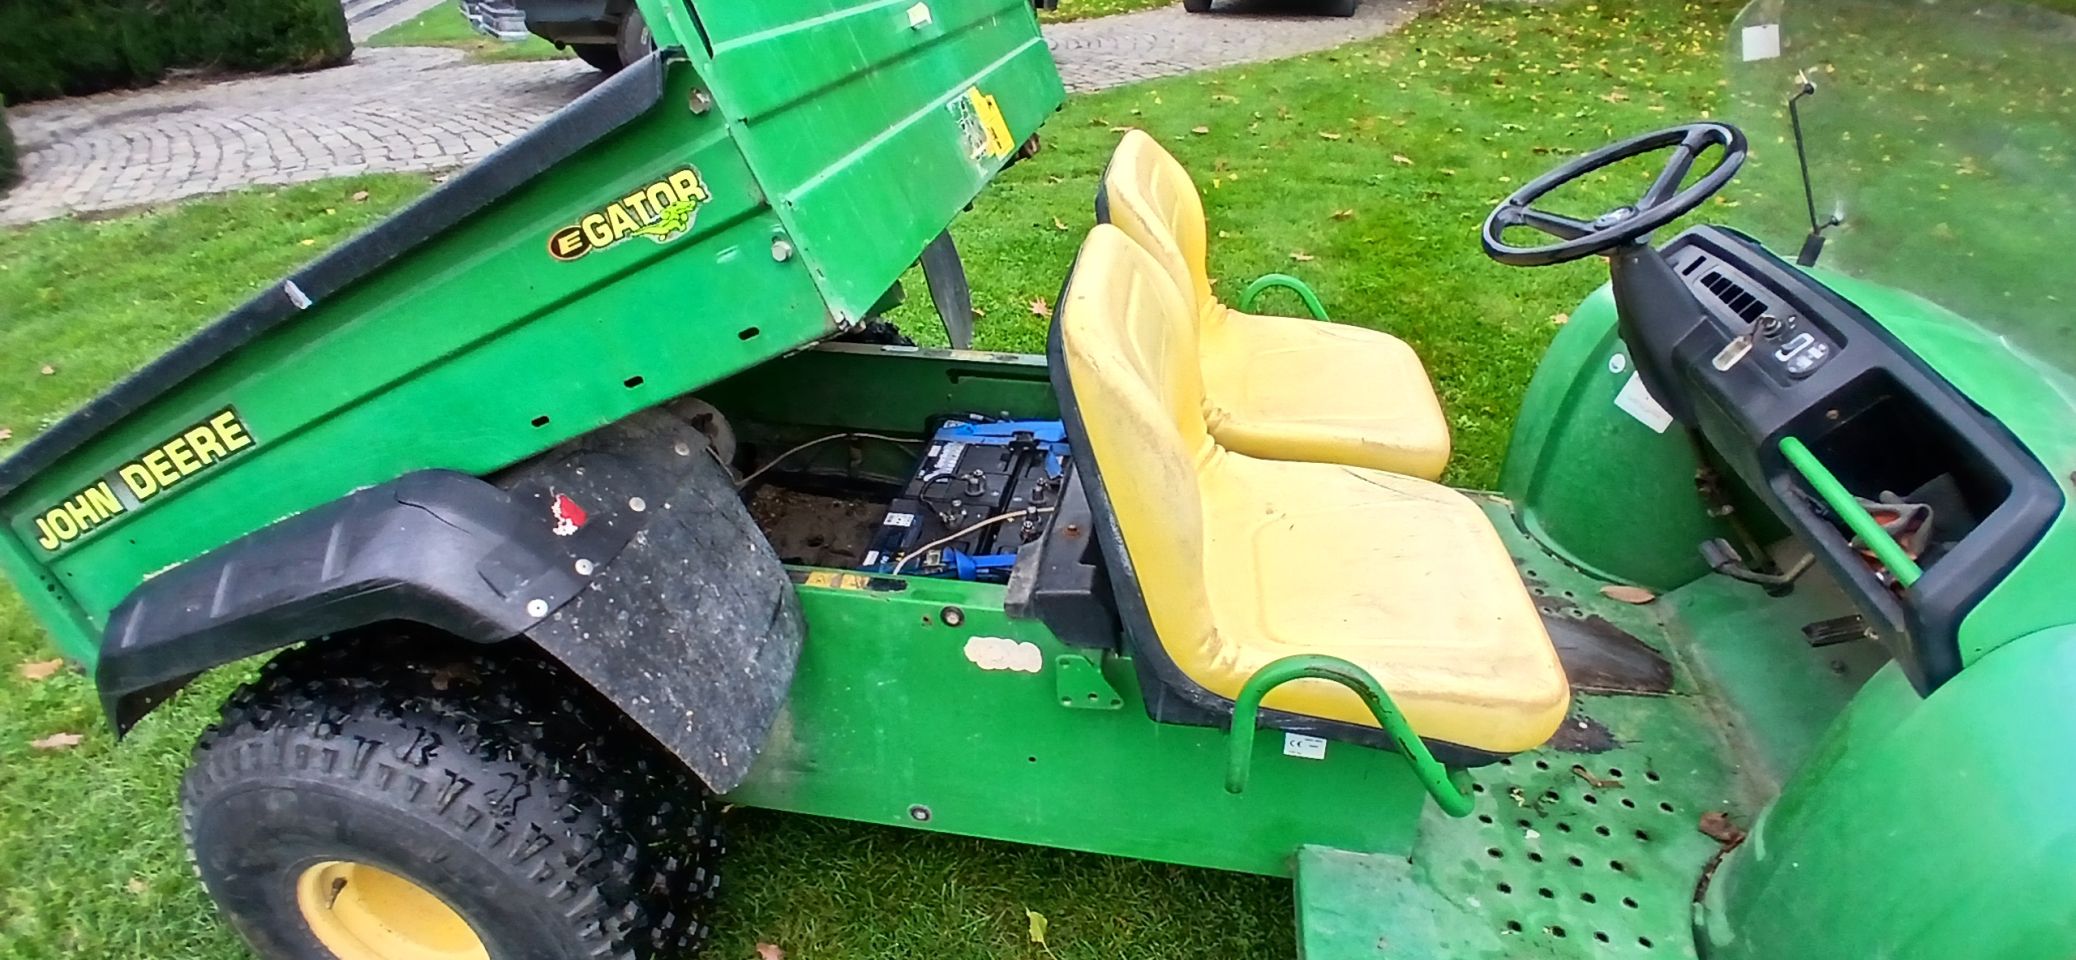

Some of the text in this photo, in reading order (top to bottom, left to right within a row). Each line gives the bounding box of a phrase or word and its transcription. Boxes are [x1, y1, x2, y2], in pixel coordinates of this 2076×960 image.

[581, 169, 707, 248] GATOR
[36, 410, 252, 550] JOHN DEERE
